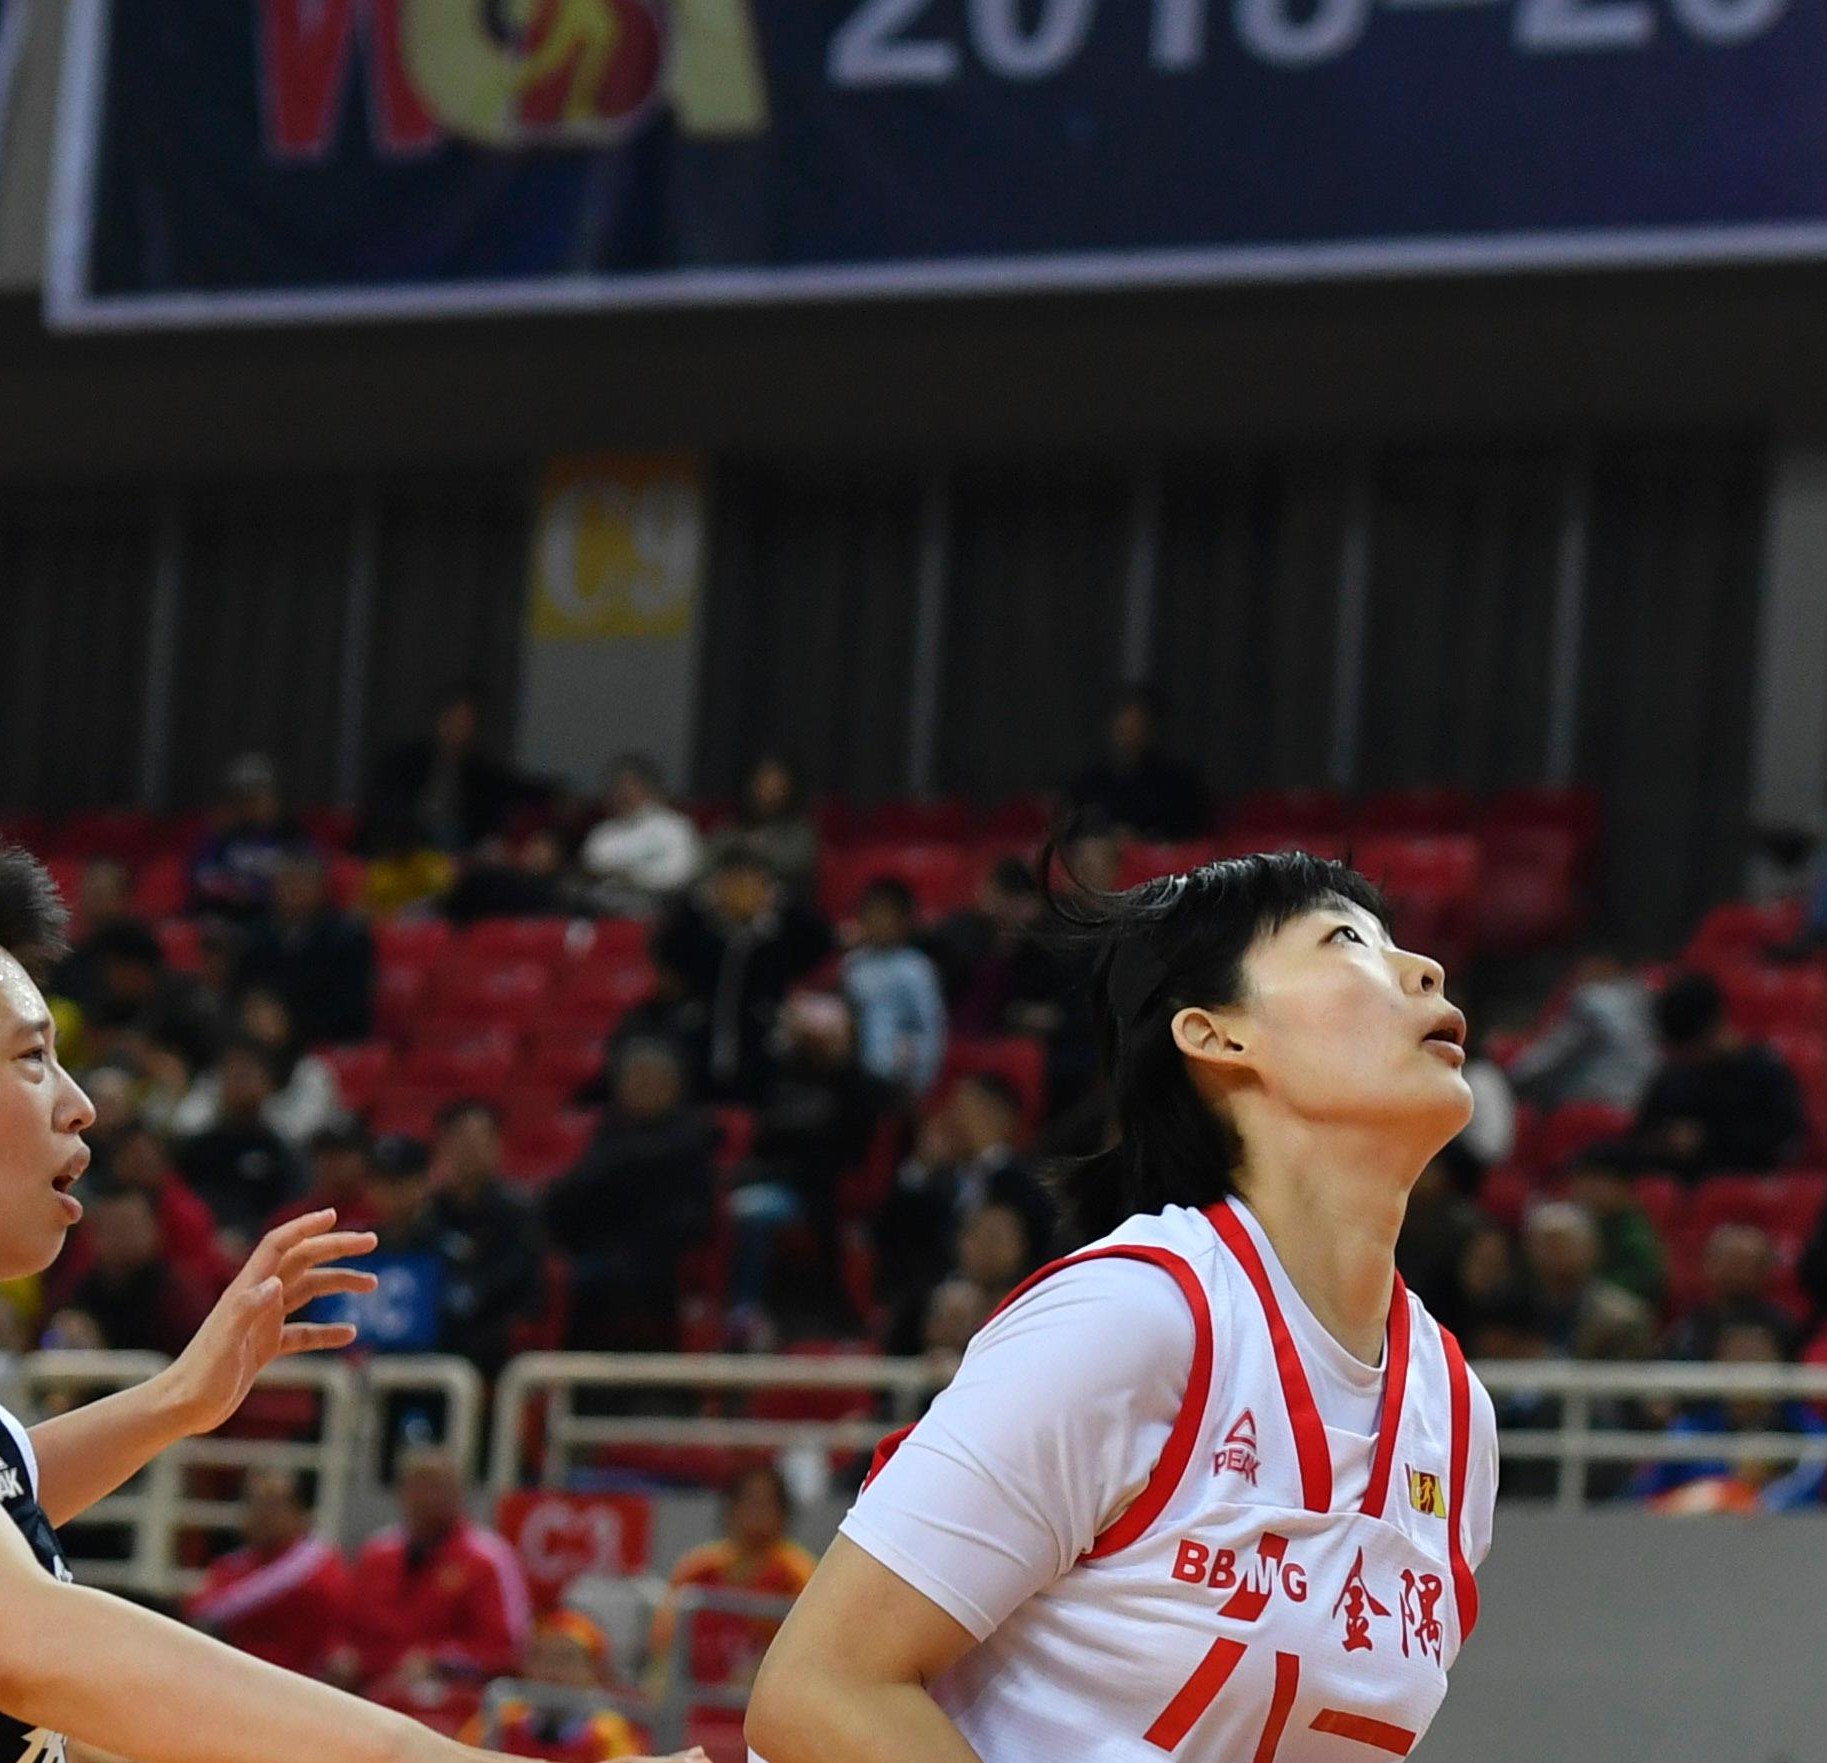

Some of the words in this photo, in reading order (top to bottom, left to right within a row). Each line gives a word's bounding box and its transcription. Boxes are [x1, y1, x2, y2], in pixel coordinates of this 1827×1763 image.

[518, 1505, 628, 1582] C1
[1172, 1531, 1308, 1623] BBMG
[1333, 1546, 1445, 1670] 金隅
